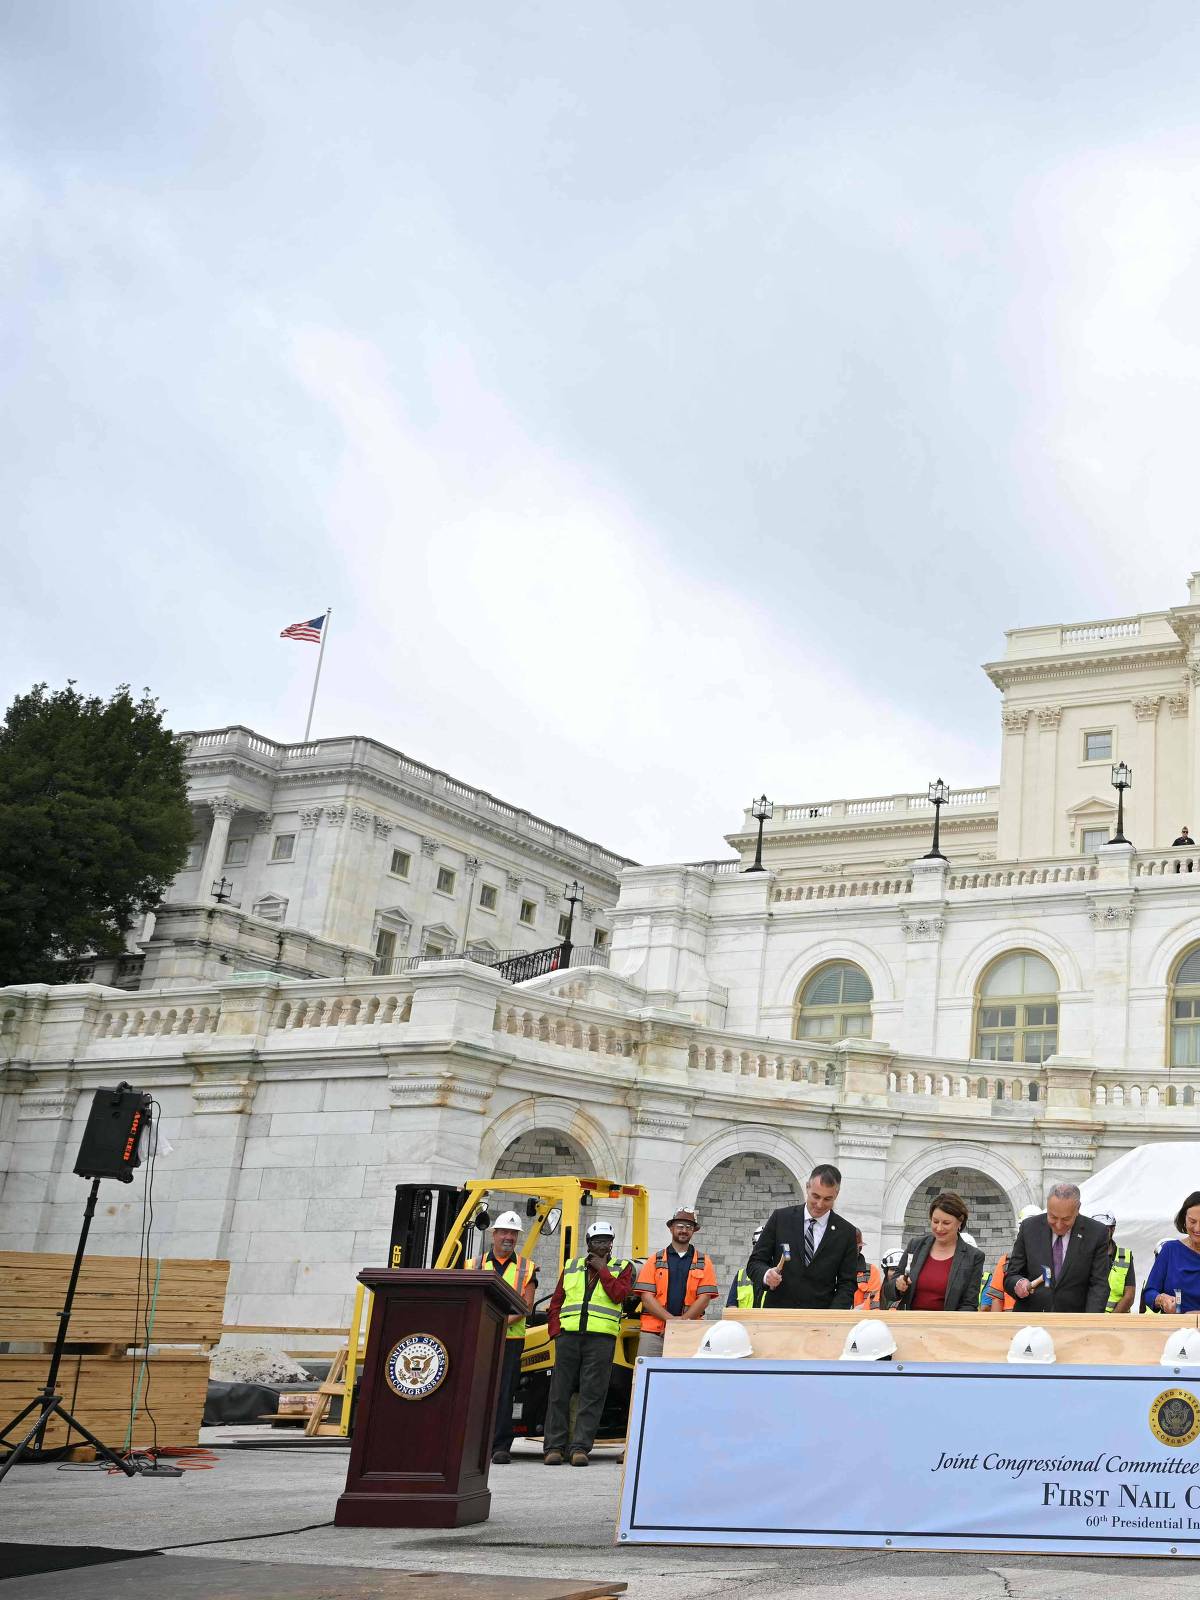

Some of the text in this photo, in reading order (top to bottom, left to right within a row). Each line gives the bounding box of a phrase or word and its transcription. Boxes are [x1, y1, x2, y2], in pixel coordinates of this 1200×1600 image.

[389, 1337, 445, 1366] UNITED STATES
[392, 1380, 437, 1395] CONGRESS
[1151, 1391, 1200, 1414] UNITED STATES
[1156, 1430, 1196, 1444] CONGRESS
[931, 1452, 978, 1472] Joint
[983, 1452, 1107, 1479] Congressional
[1105, 1453, 1200, 1475] Committee
[1041, 1482, 1110, 1507] FIRST
[1118, 1483, 1176, 1509] NAIL
[1085, 1514, 1108, 1527] 60th
[1111, 1515, 1183, 1529] Presidential
